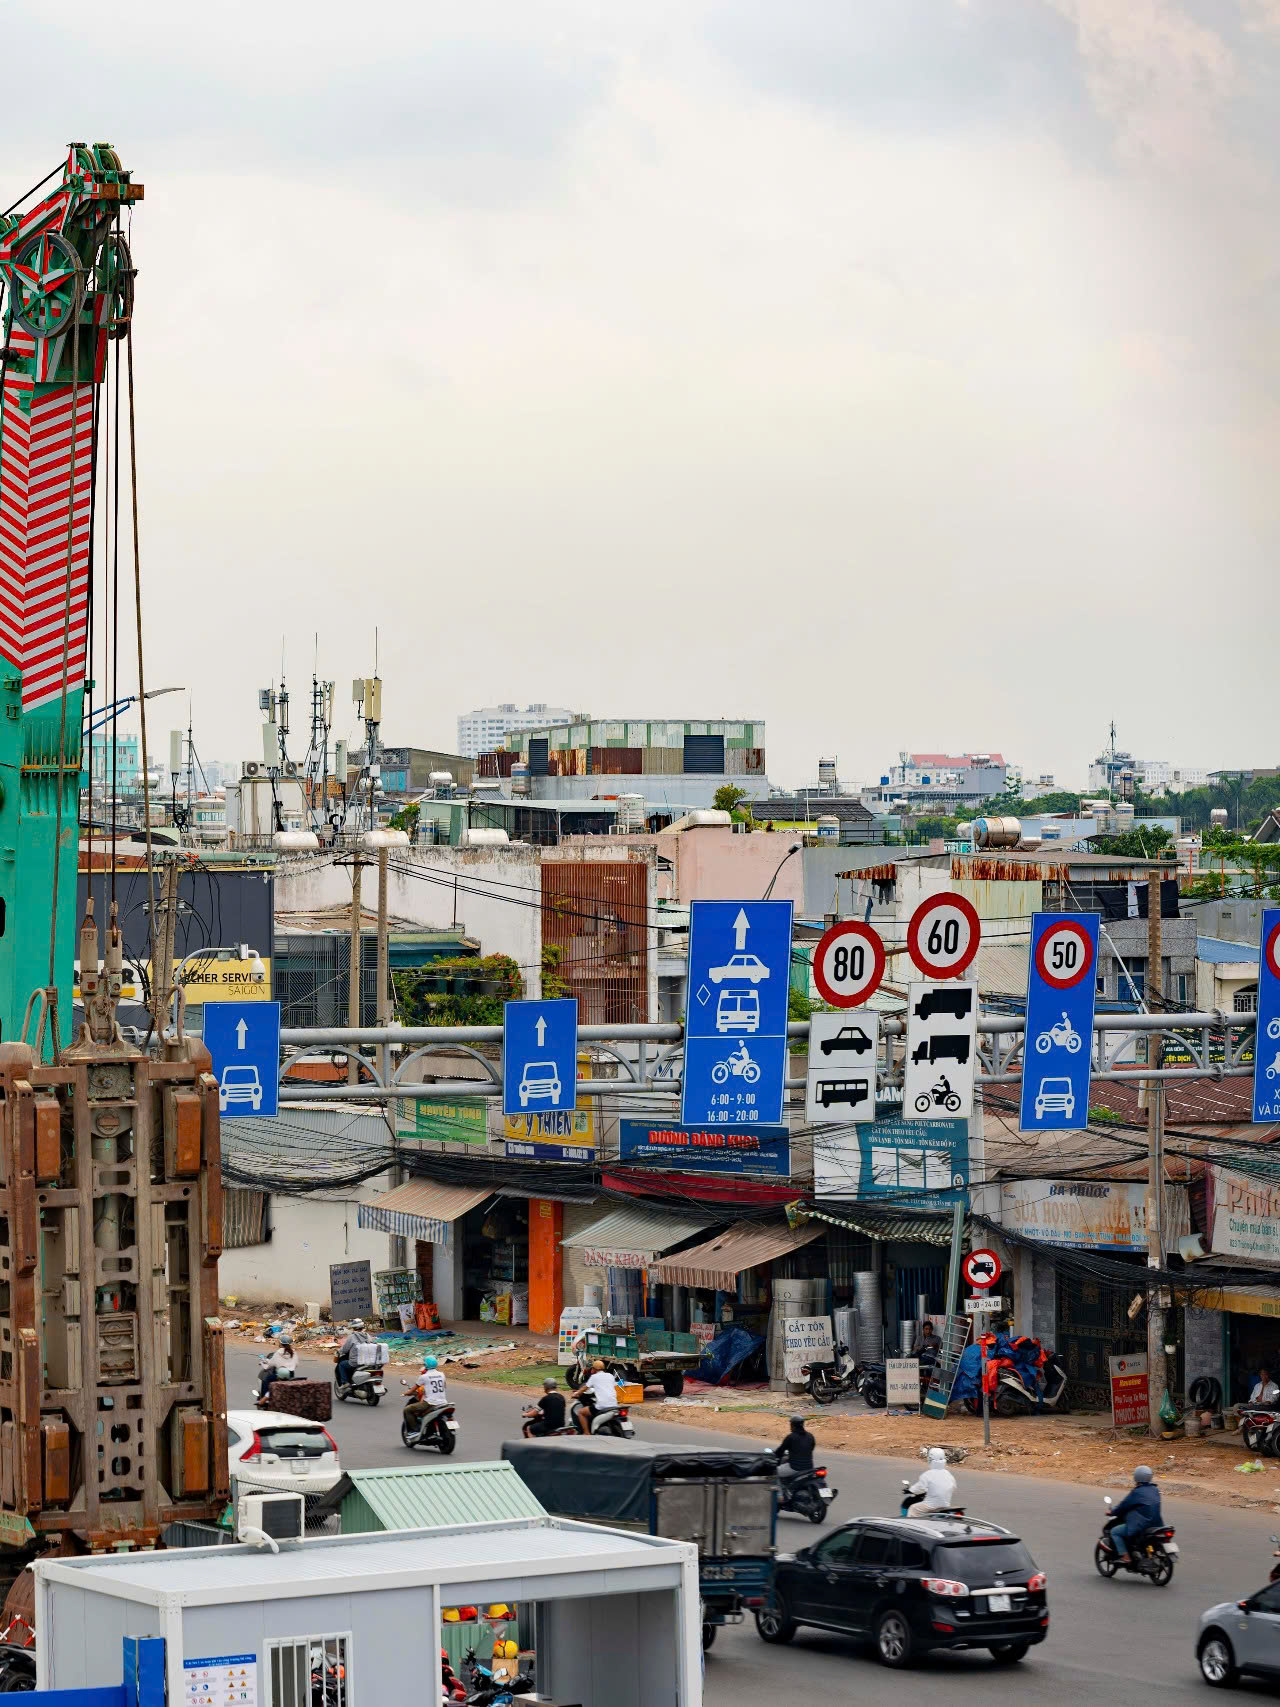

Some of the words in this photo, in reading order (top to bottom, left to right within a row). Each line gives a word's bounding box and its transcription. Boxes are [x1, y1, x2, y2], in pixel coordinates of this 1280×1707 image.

[927, 918, 960, 955] 60
[1051, 940, 1077, 970] 50
[833, 945, 865, 982] 80
[711, 1093, 729, 1105] 6:00
[736, 1093, 756, 1105] 9:00
[707, 1110, 729, 1122] 16:00
[736, 1109, 759, 1121] 20:00
[1258, 1102, 1271, 1115] VÀ
[1049, 1184, 1065, 1196] BA
[614, 1252, 647, 1267] KHOA
[789, 1320, 805, 1333] CẮT
[807, 1319, 825, 1331] TÔN
[786, 1338, 803, 1348] THEO
[804, 1335, 816, 1347] YÊU
[817, 1333, 831, 1347] CẦU
[430, 1379, 445, 1394] 39
